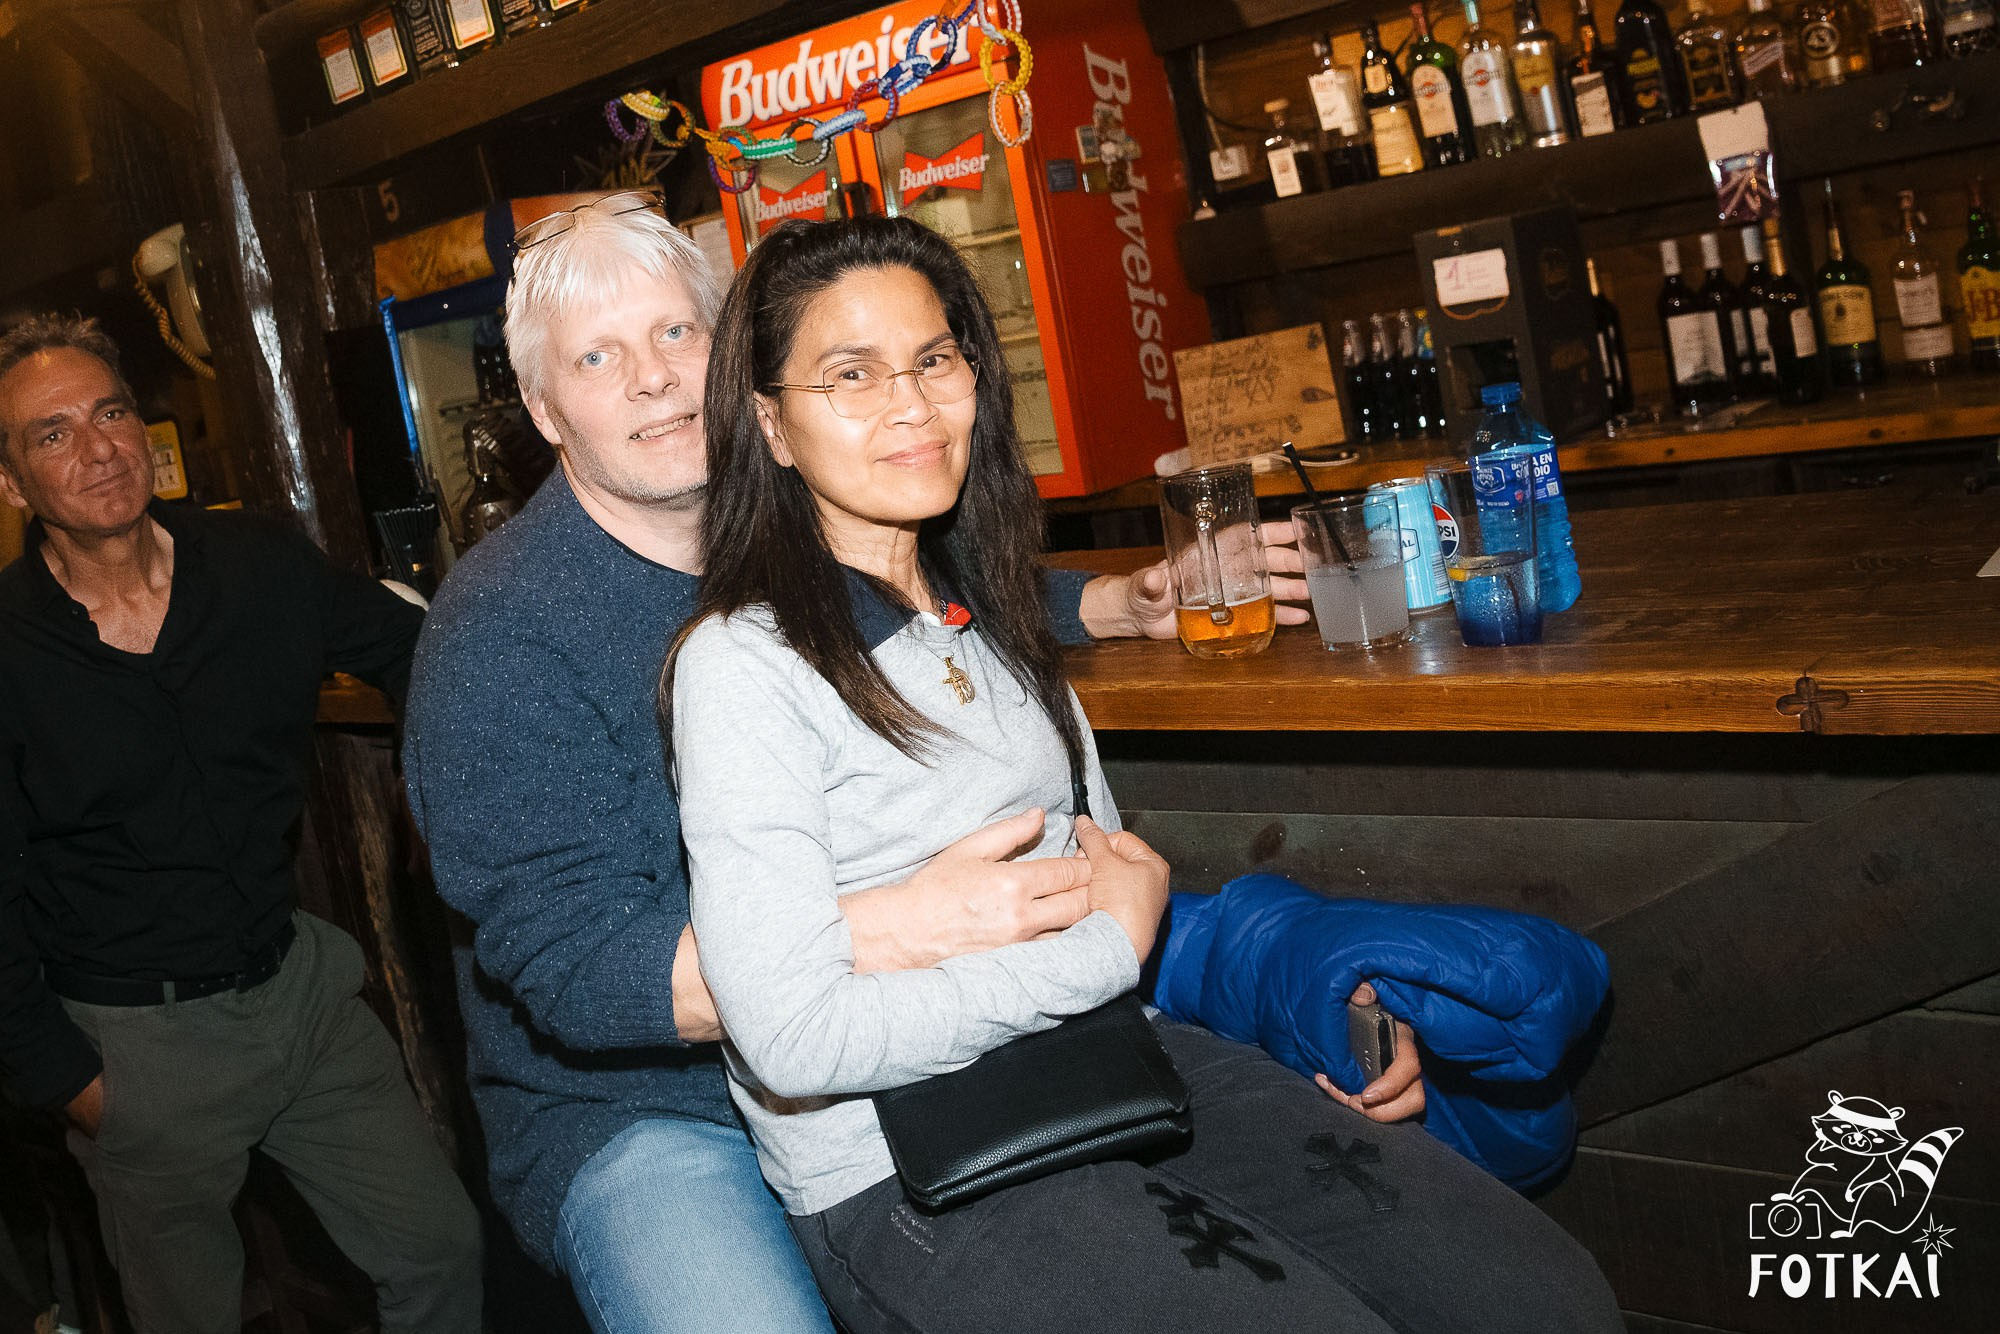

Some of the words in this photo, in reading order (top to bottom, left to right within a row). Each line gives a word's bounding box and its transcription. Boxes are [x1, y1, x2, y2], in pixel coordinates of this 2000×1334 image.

[899, 153, 990, 192] Budweiser
[378, 179, 399, 222] 5
[755, 189, 831, 223] Budweiser
[1540, 452, 1553, 466] EN
